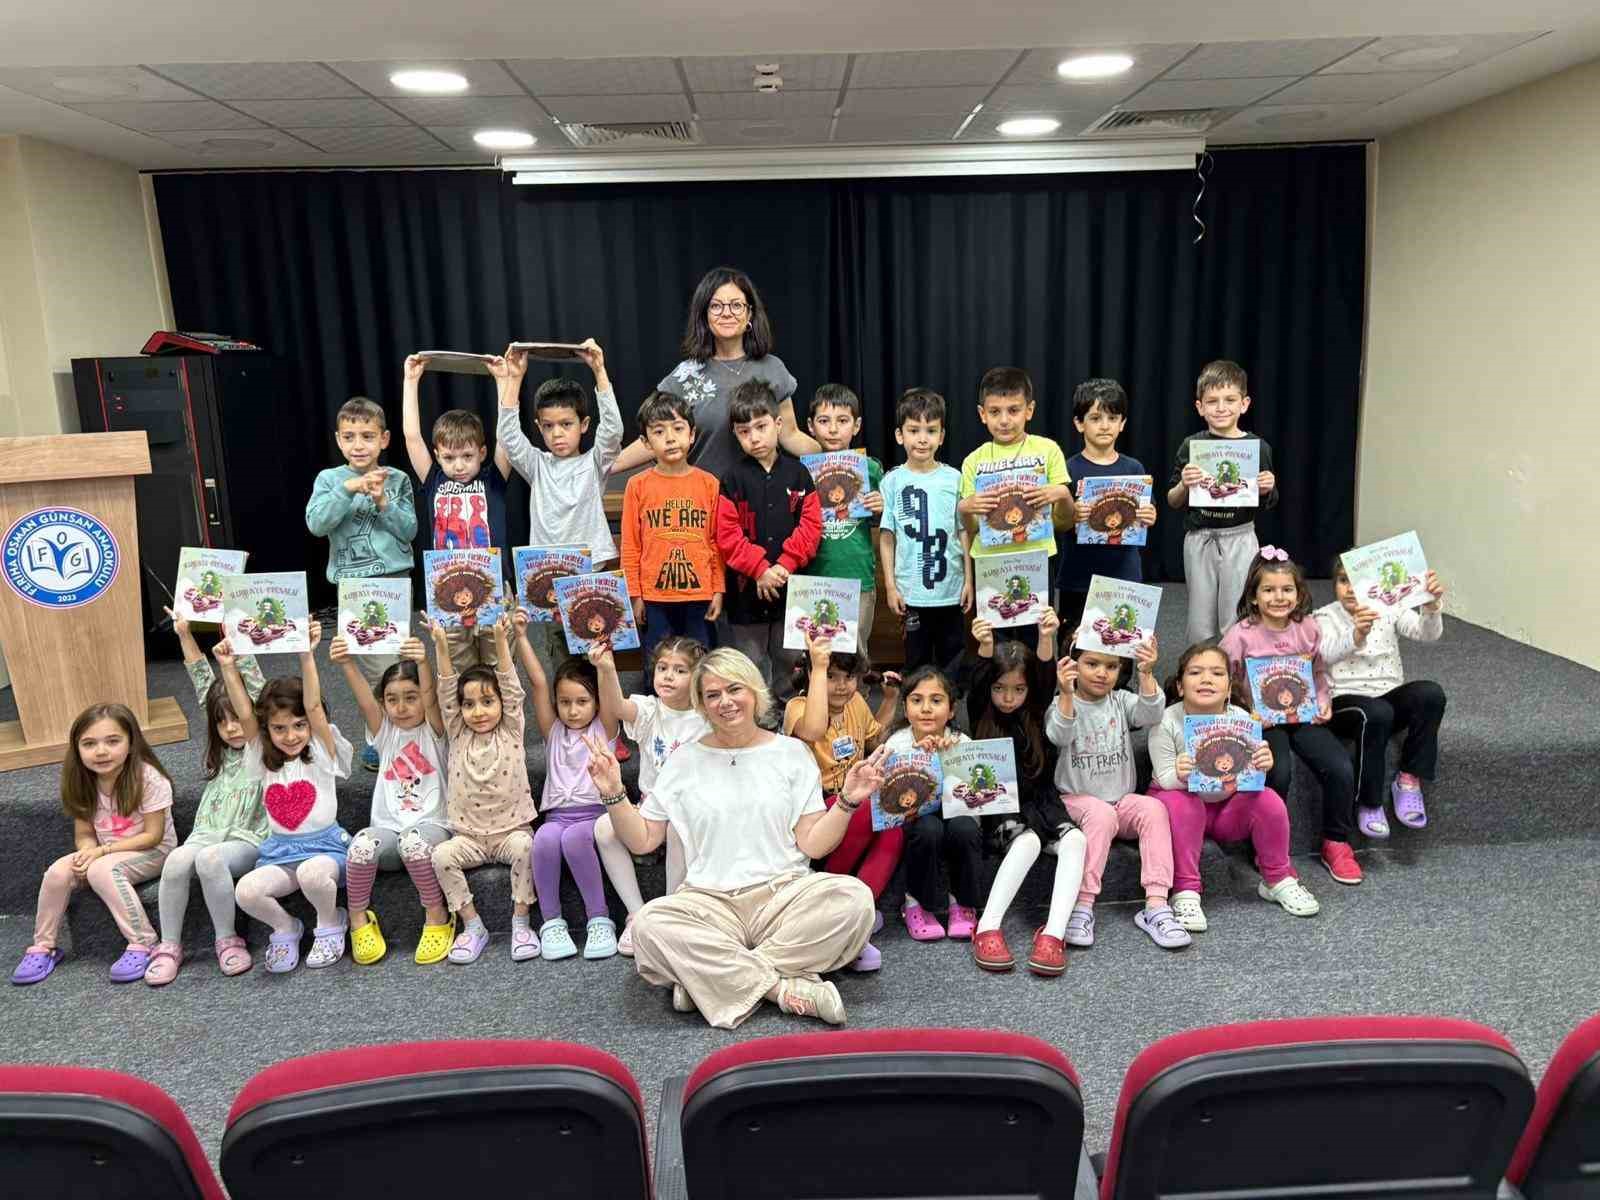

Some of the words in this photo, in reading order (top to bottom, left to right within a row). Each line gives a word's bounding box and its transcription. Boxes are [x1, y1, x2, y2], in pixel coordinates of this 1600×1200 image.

[646, 509, 671, 528] WE
[679, 508, 707, 528] ARE
[8, 520, 37, 556] OSMAN
[655, 562, 701, 589] ENDS
[1072, 754, 1093, 769] BEST
